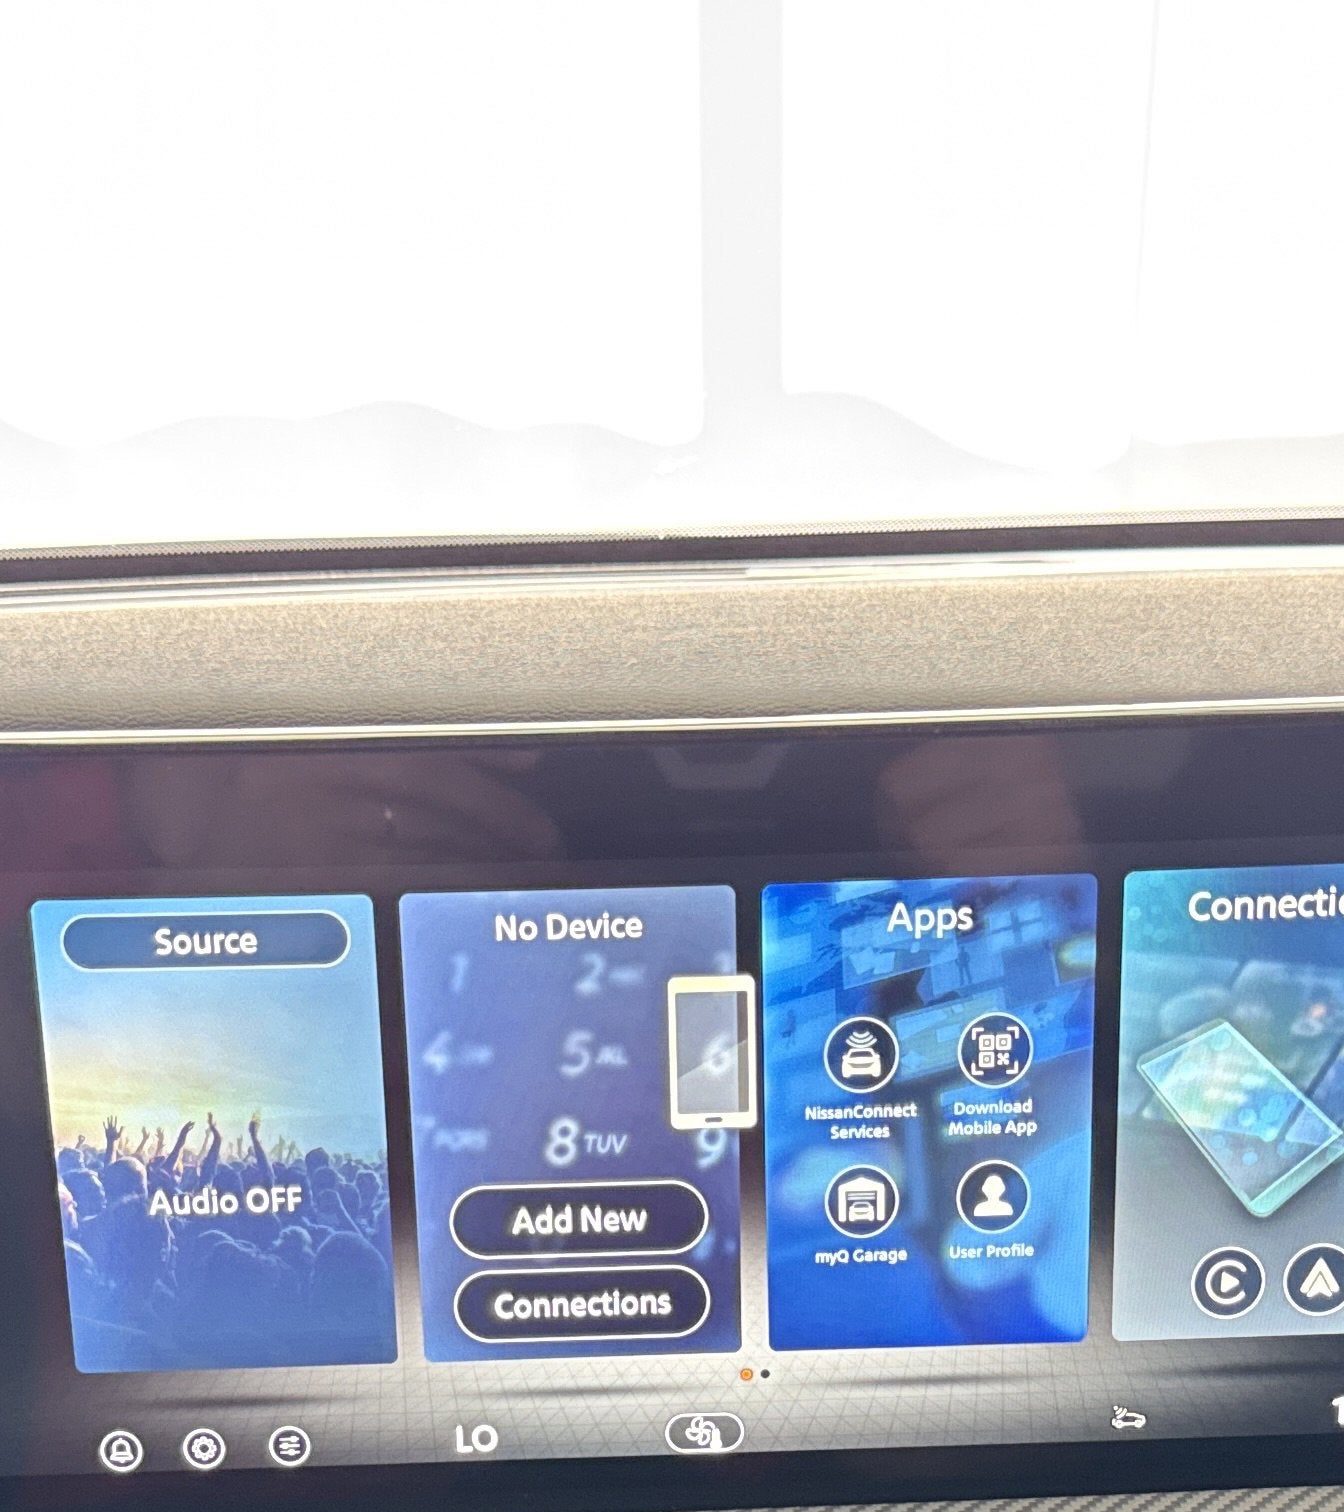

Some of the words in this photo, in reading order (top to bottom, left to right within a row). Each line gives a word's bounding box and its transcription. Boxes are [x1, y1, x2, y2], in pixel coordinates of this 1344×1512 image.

[494, 914, 538, 942] No
[545, 911, 644, 940] Device
[887, 902, 974, 938] Apps
[154, 928, 258, 956] Source
[805, 1103, 918, 1121] NissanConnect
[953, 1097, 1033, 1116] Download
[545, 1117, 580, 1167] 8
[584, 1134, 628, 1155] TUV
[830, 1124, 891, 1140] Services
[948, 1120, 1002, 1136] Mobile
[1004, 1120, 1038, 1137] App
[149, 1188, 239, 1217] Audio
[245, 1186, 303, 1213] OFF
[512, 1205, 573, 1236] Add
[580, 1205, 648, 1234] New
[815, 1250, 850, 1266] myQ
[852, 1248, 908, 1266] Garage
[949, 1245, 984, 1260] User
[986, 1243, 1035, 1259] Profile
[494, 1290, 673, 1320] Connections
[454, 1424, 499, 1454] LO
